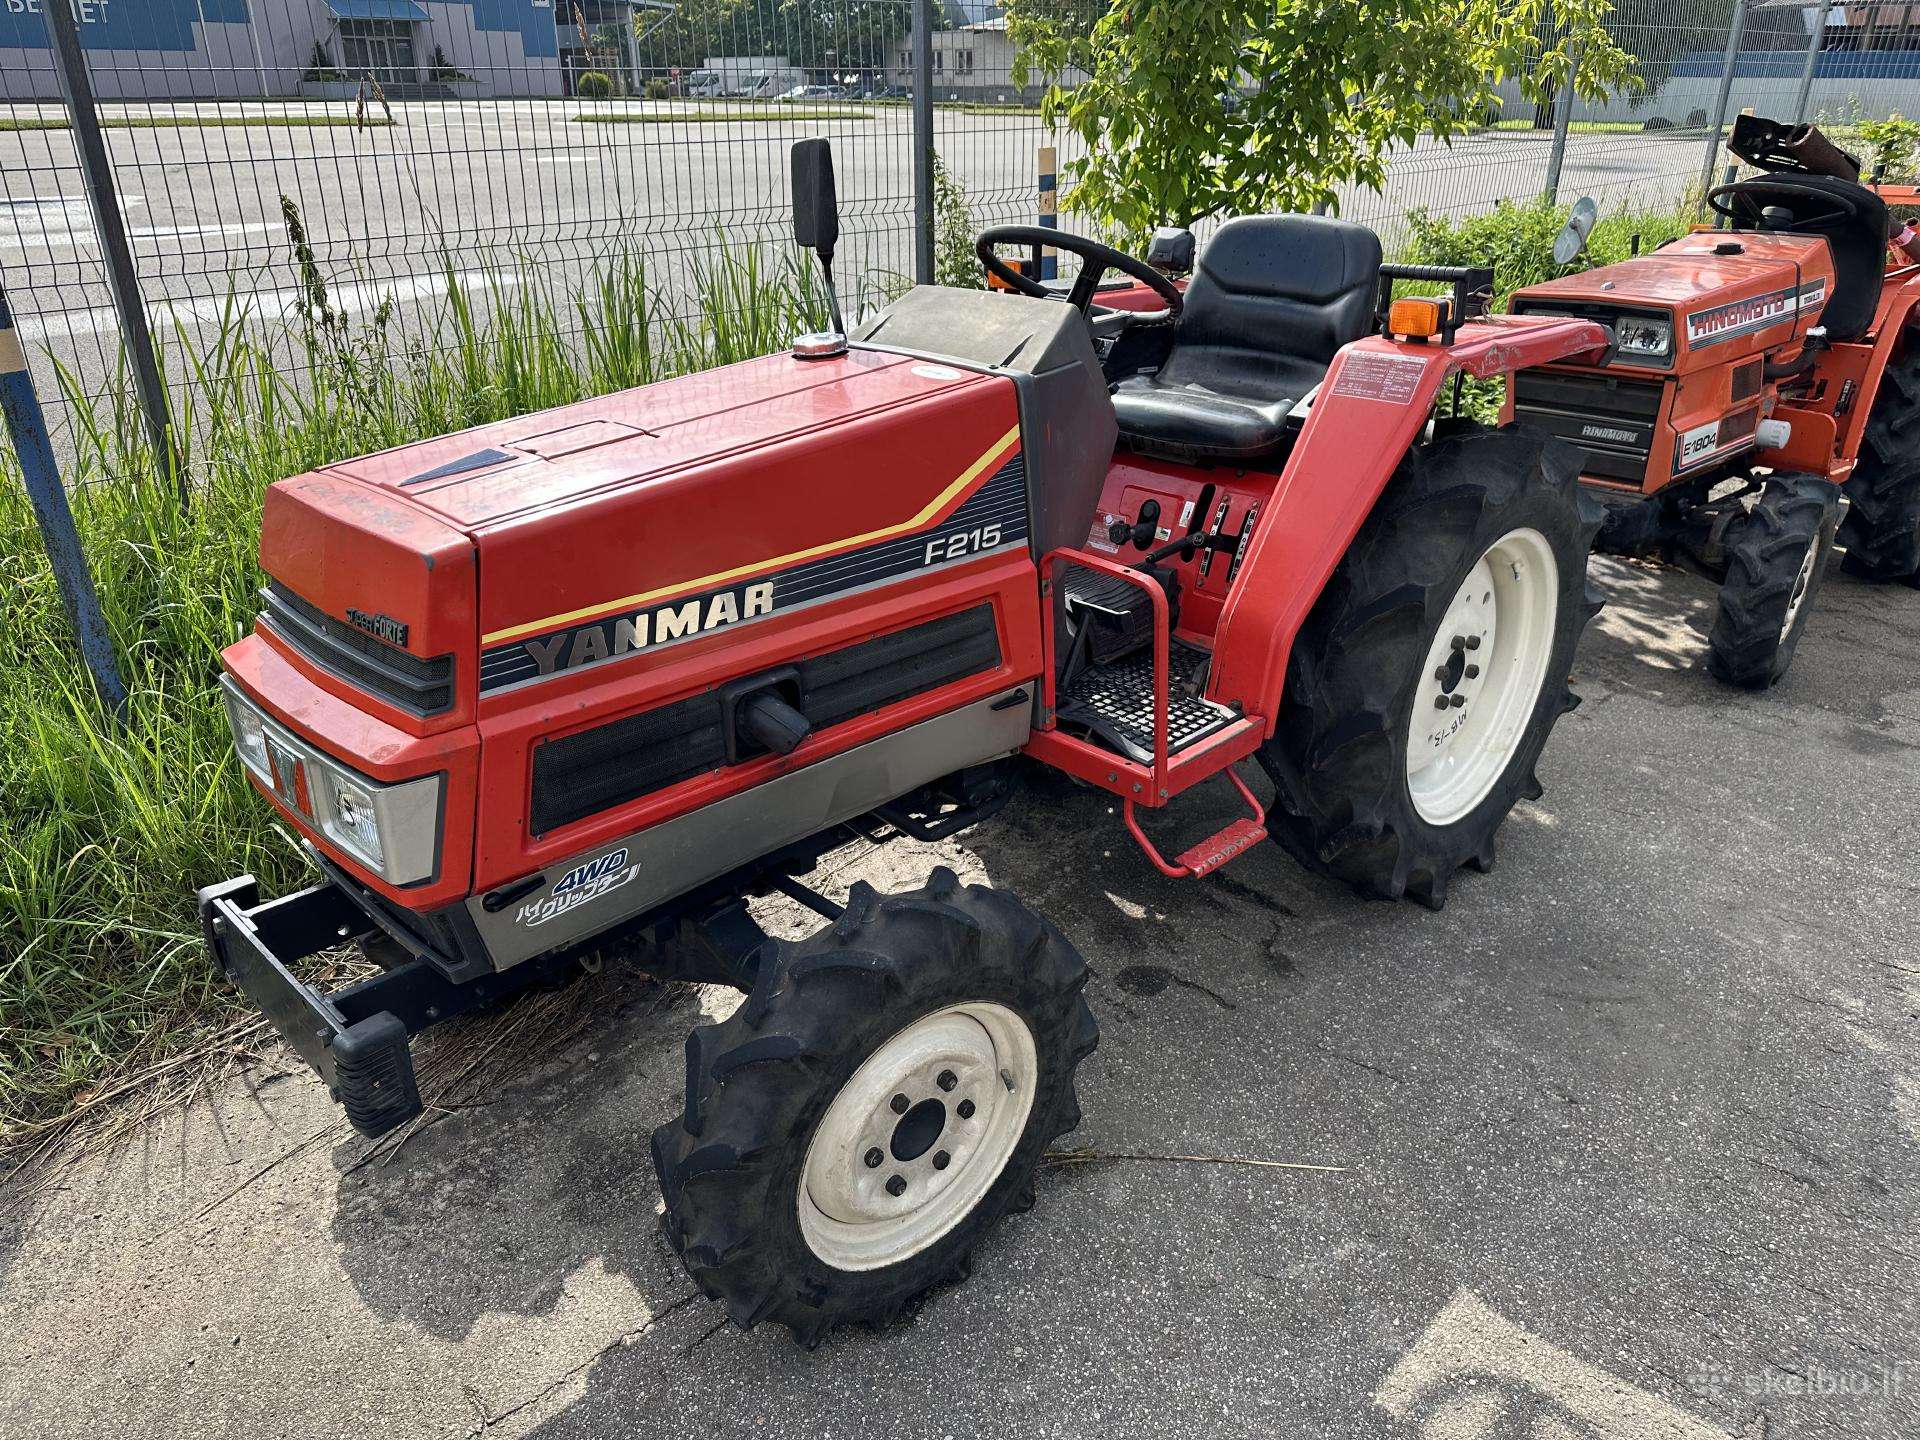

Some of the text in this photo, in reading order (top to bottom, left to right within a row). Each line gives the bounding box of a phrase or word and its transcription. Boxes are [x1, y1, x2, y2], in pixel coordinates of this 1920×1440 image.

[1694, 294, 1785, 337] HINOMOTO
[1683, 432, 1717, 456] E1804
[922, 523, 1002, 566] F215
[523, 580, 775, 677] YANMAR
[552, 848, 629, 897] 4WD
